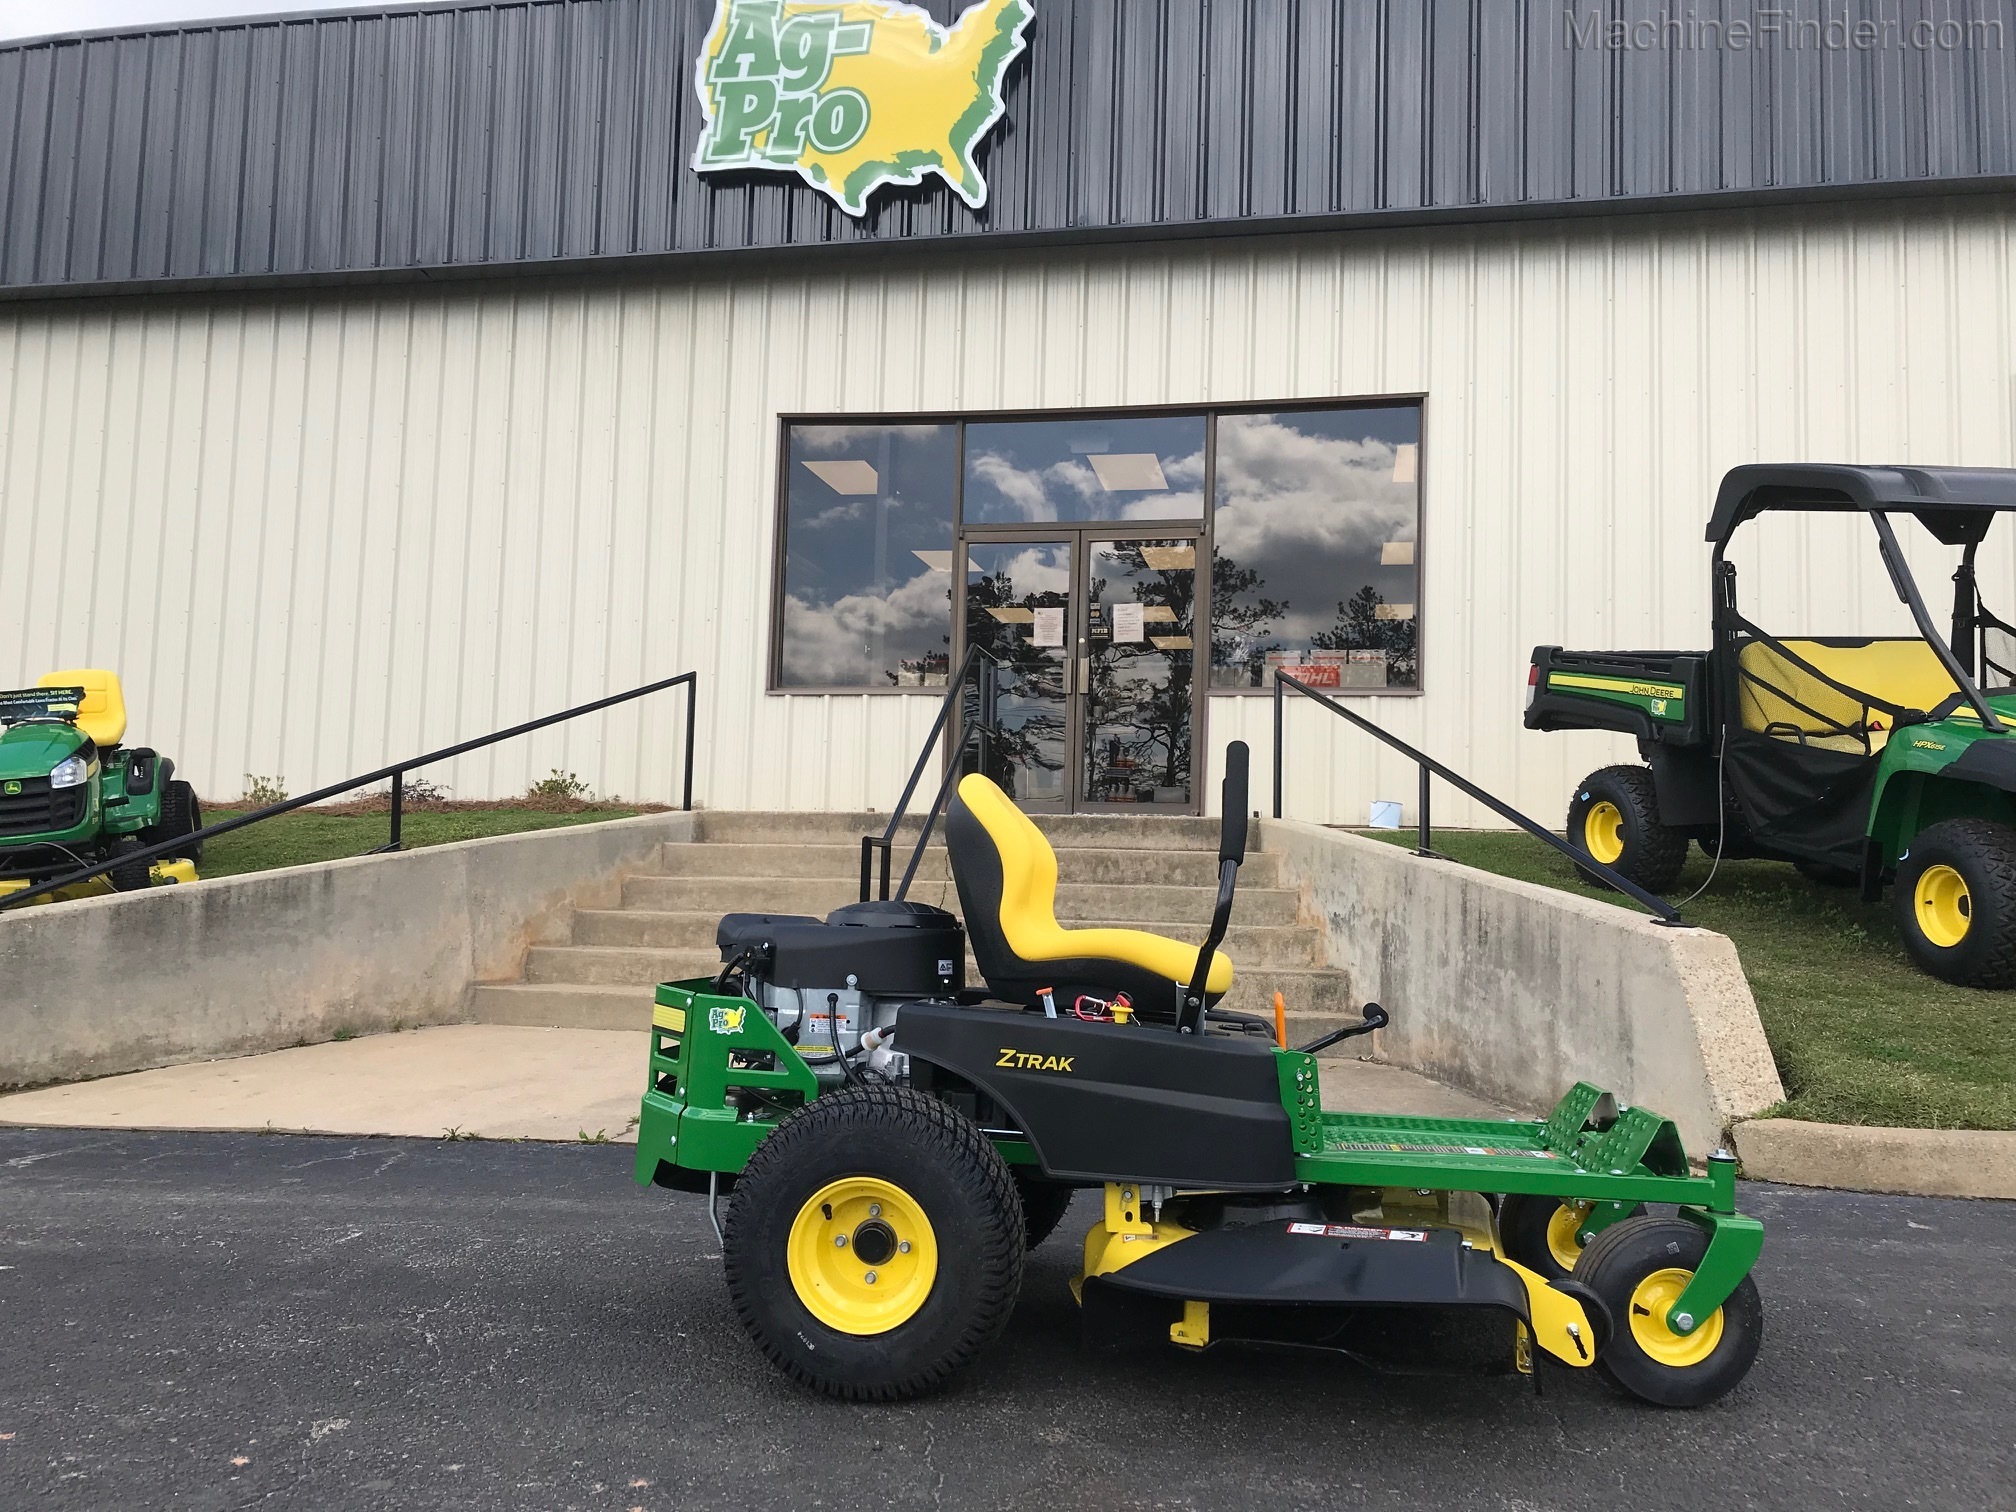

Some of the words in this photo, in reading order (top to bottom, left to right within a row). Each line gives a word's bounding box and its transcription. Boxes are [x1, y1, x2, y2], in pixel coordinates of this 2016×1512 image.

[708, 0, 873, 91] Ag-
[705, 78, 869, 162] Pro
[1630, 685, 1649, 694] JOHN
[1650, 687, 1674, 697] DEERE
[712, 1018, 728, 1028] Pro
[995, 1048, 1075, 1072] ZTRAK
